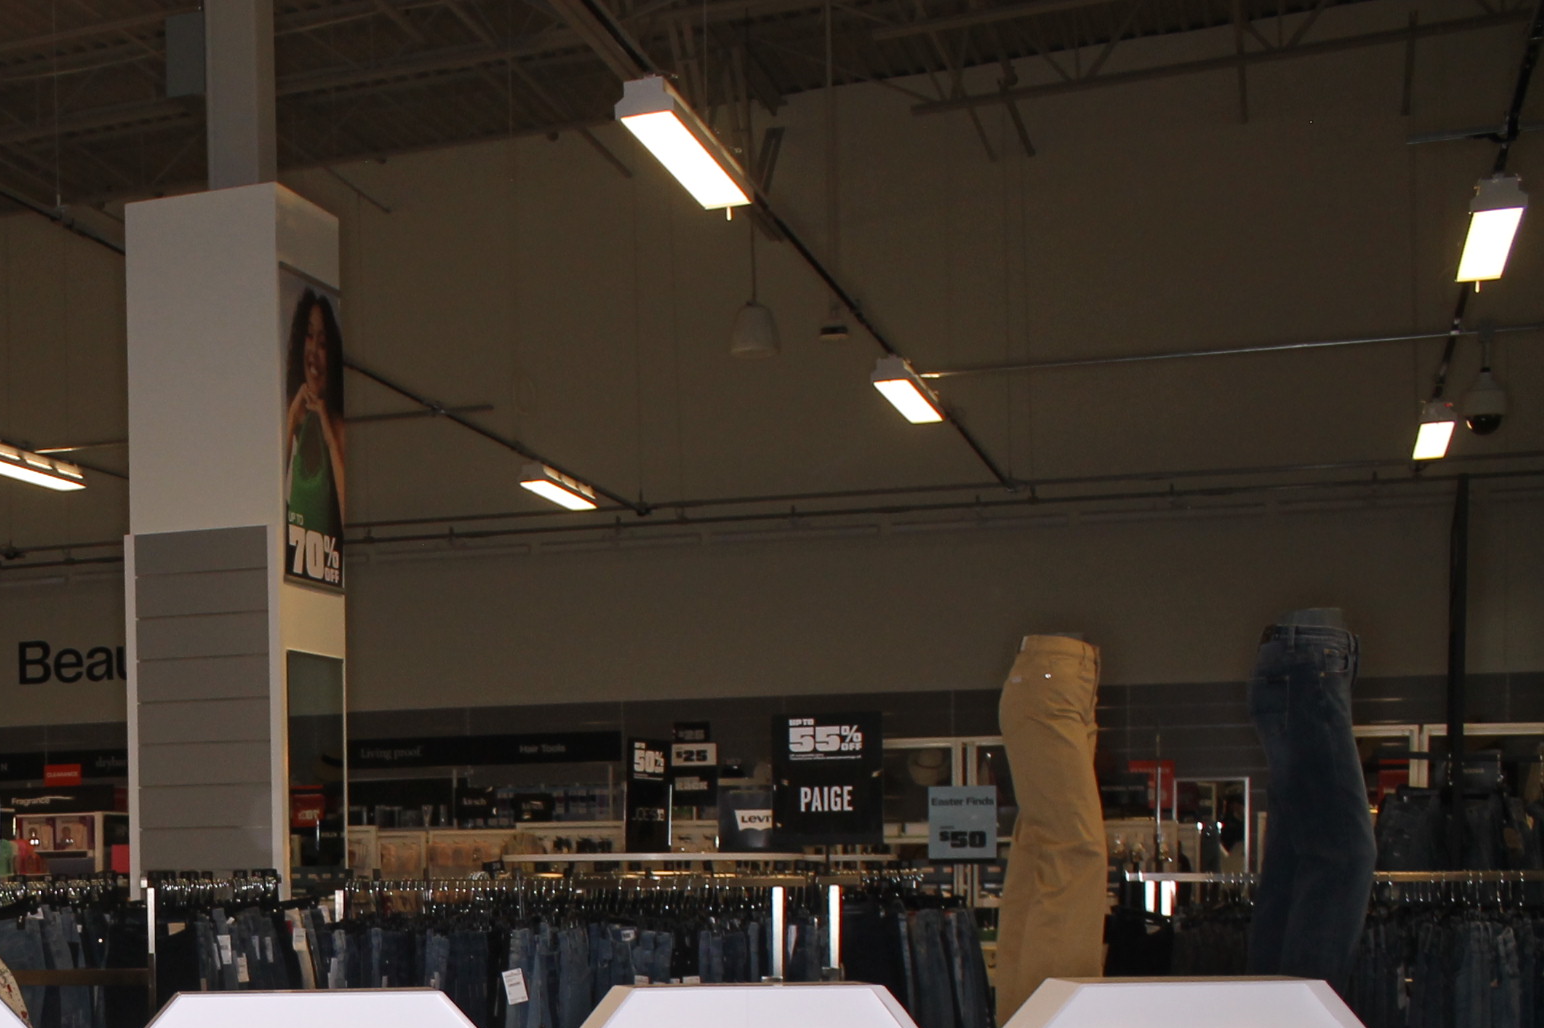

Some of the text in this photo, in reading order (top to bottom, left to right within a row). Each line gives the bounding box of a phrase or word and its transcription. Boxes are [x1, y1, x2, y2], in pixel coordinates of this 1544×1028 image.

[288, 524, 340, 580] 70%
[324, 566, 340, 584] OFF
[18, 640, 127, 685] Beau
[788, 725, 863, 753] 55%
[840, 742, 863, 752] OFF
[800, 786, 854, 812] PAIGE
[931, 796, 995, 806] Easter Finds
[939, 831, 986, 848] $50
